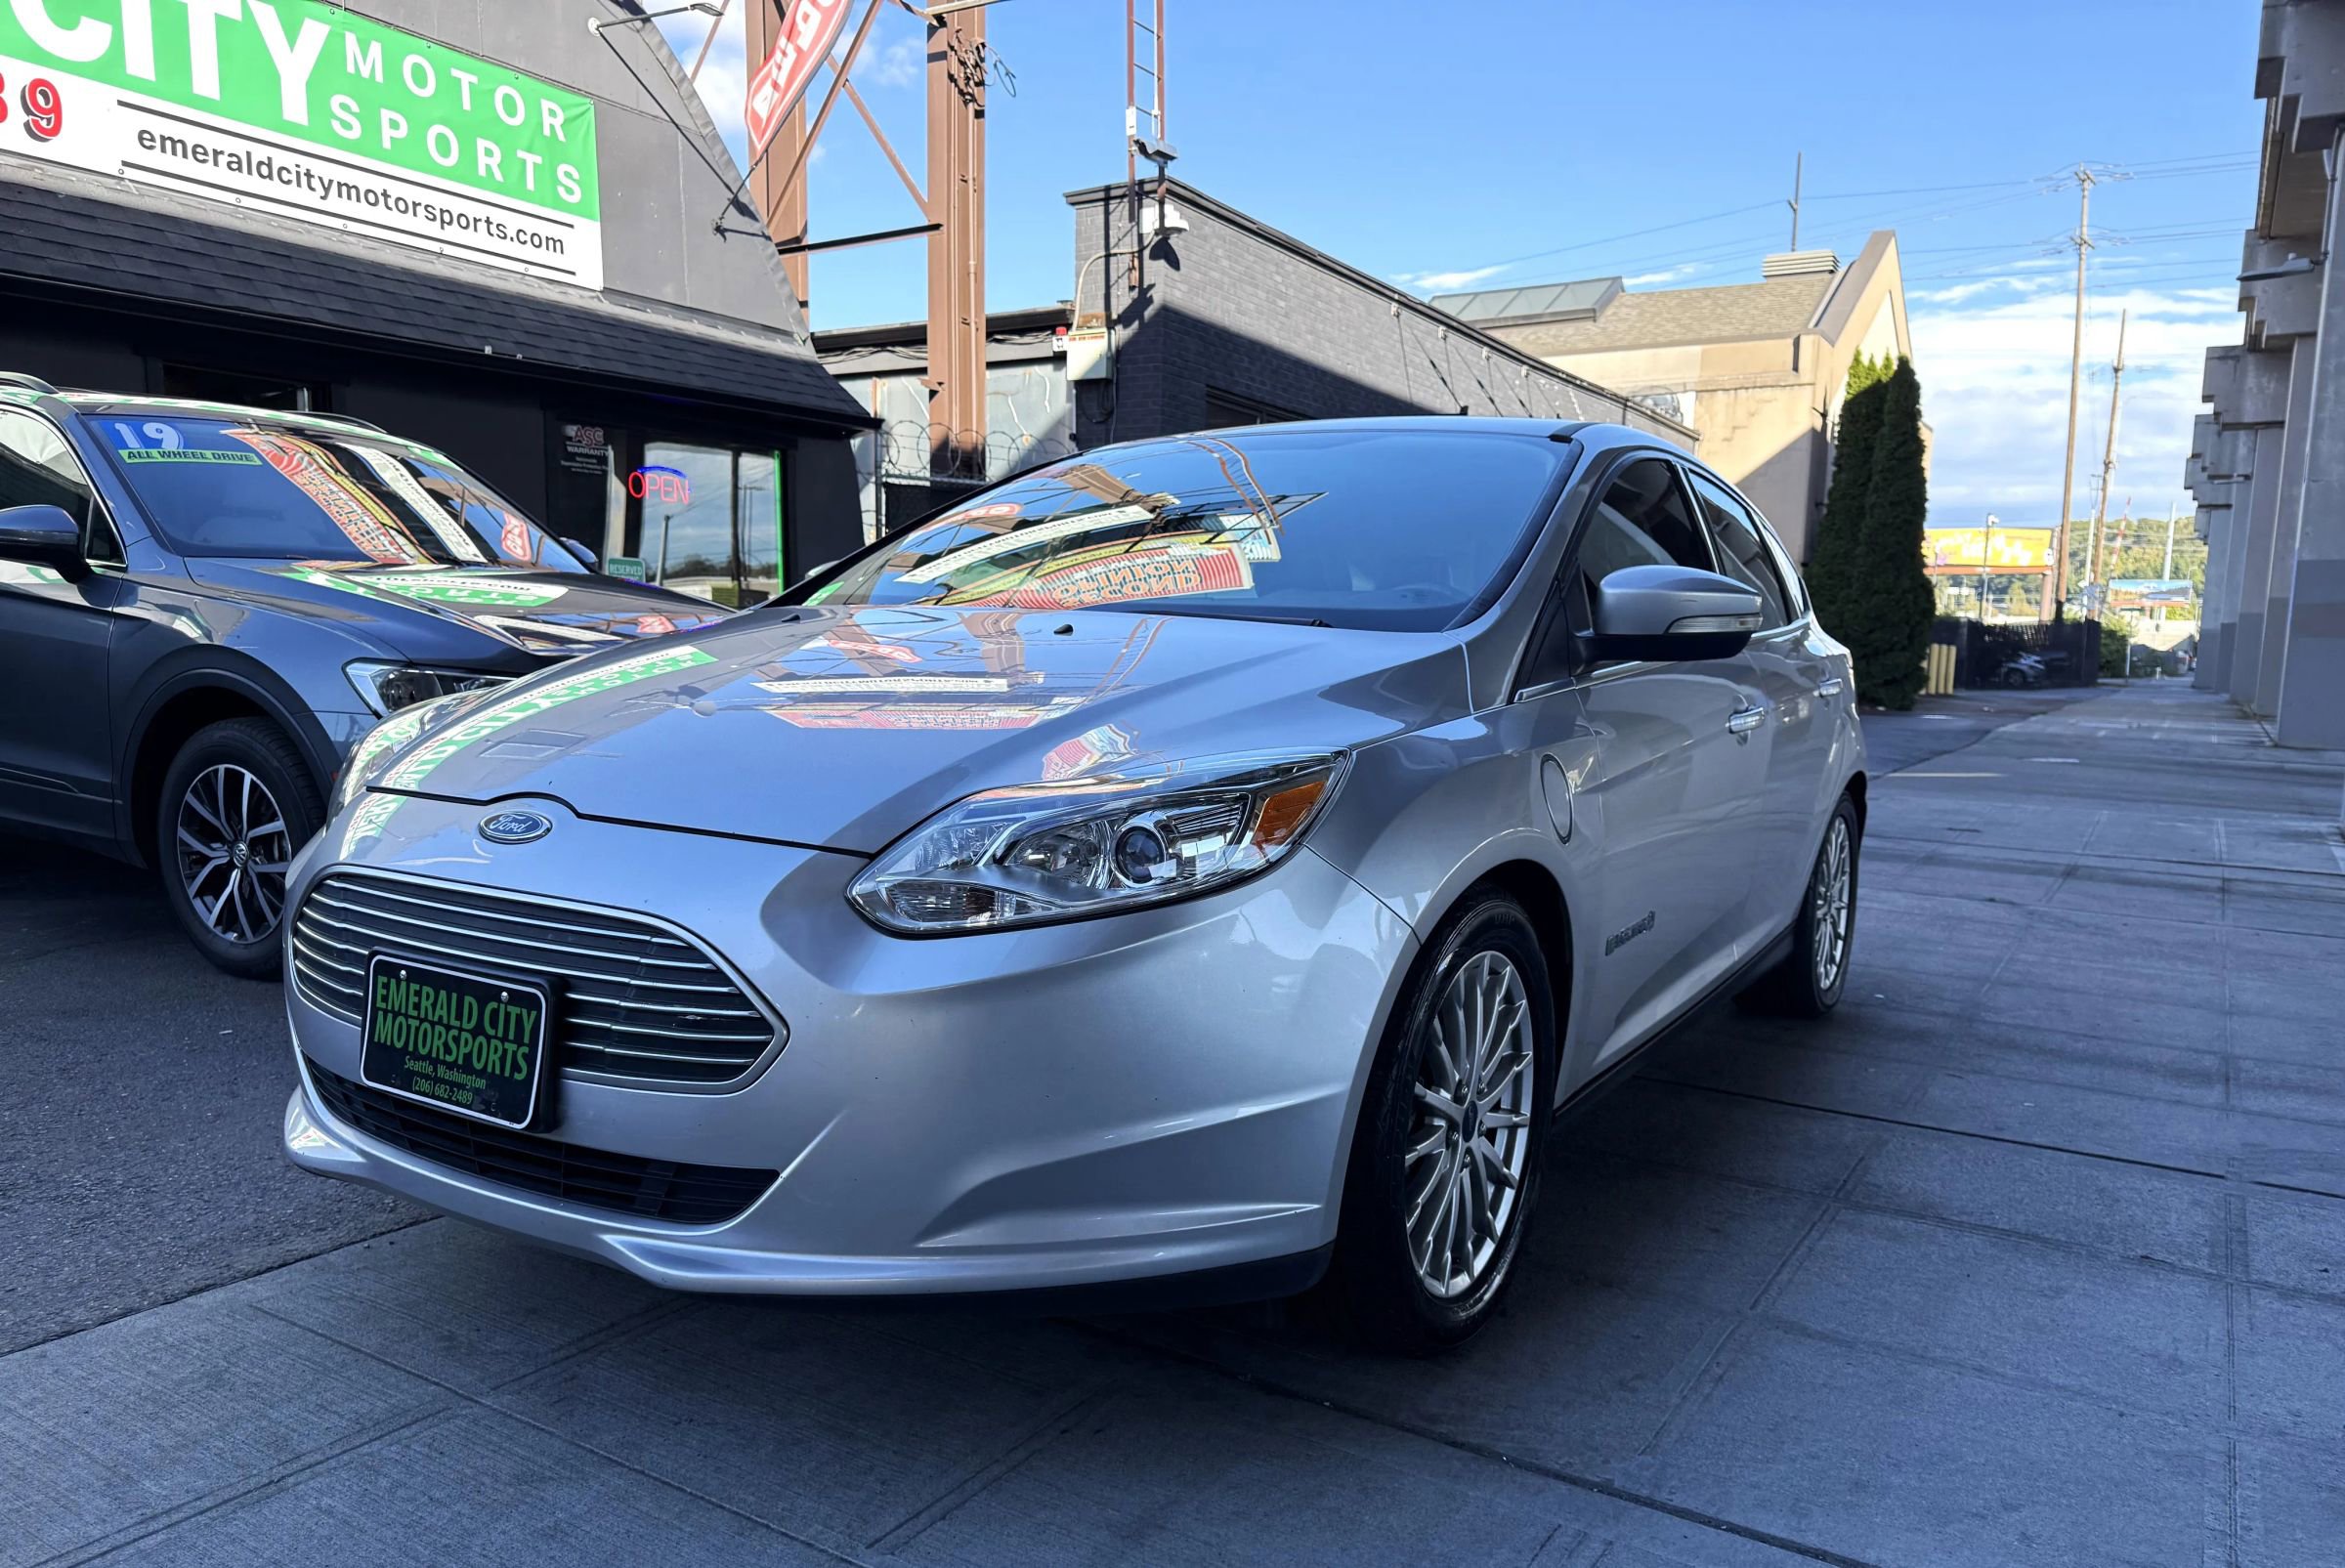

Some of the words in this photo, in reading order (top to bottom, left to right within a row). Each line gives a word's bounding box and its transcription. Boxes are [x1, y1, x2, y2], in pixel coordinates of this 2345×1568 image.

[345, 32, 566, 142] MOTOR
[329, 94, 582, 203] SPORTS
[137, 124, 565, 255] emeraldcitymotorsports.com
[114, 422, 182, 449] 19
[572, 425, 605, 446] ASC
[127, 450, 156, 460] ALL
[159, 450, 210, 461] WHEEL
[213, 452, 255, 462] DRIVE
[628, 471, 689, 505] OPEN
[609, 563, 643, 575] RESERVED
[489, 813, 533, 832] Ford
[375, 975, 479, 1029] EMERALD
[484, 1000, 537, 1044] CITY
[373, 1011, 530, 1081] MOTORSPORTS
[404, 1055, 436, 1078] Seattle,
[437, 1064, 487, 1090] Washington
[412, 1076, 434, 1097] (206)
[434, 1081, 474, 1105] 682-2489
